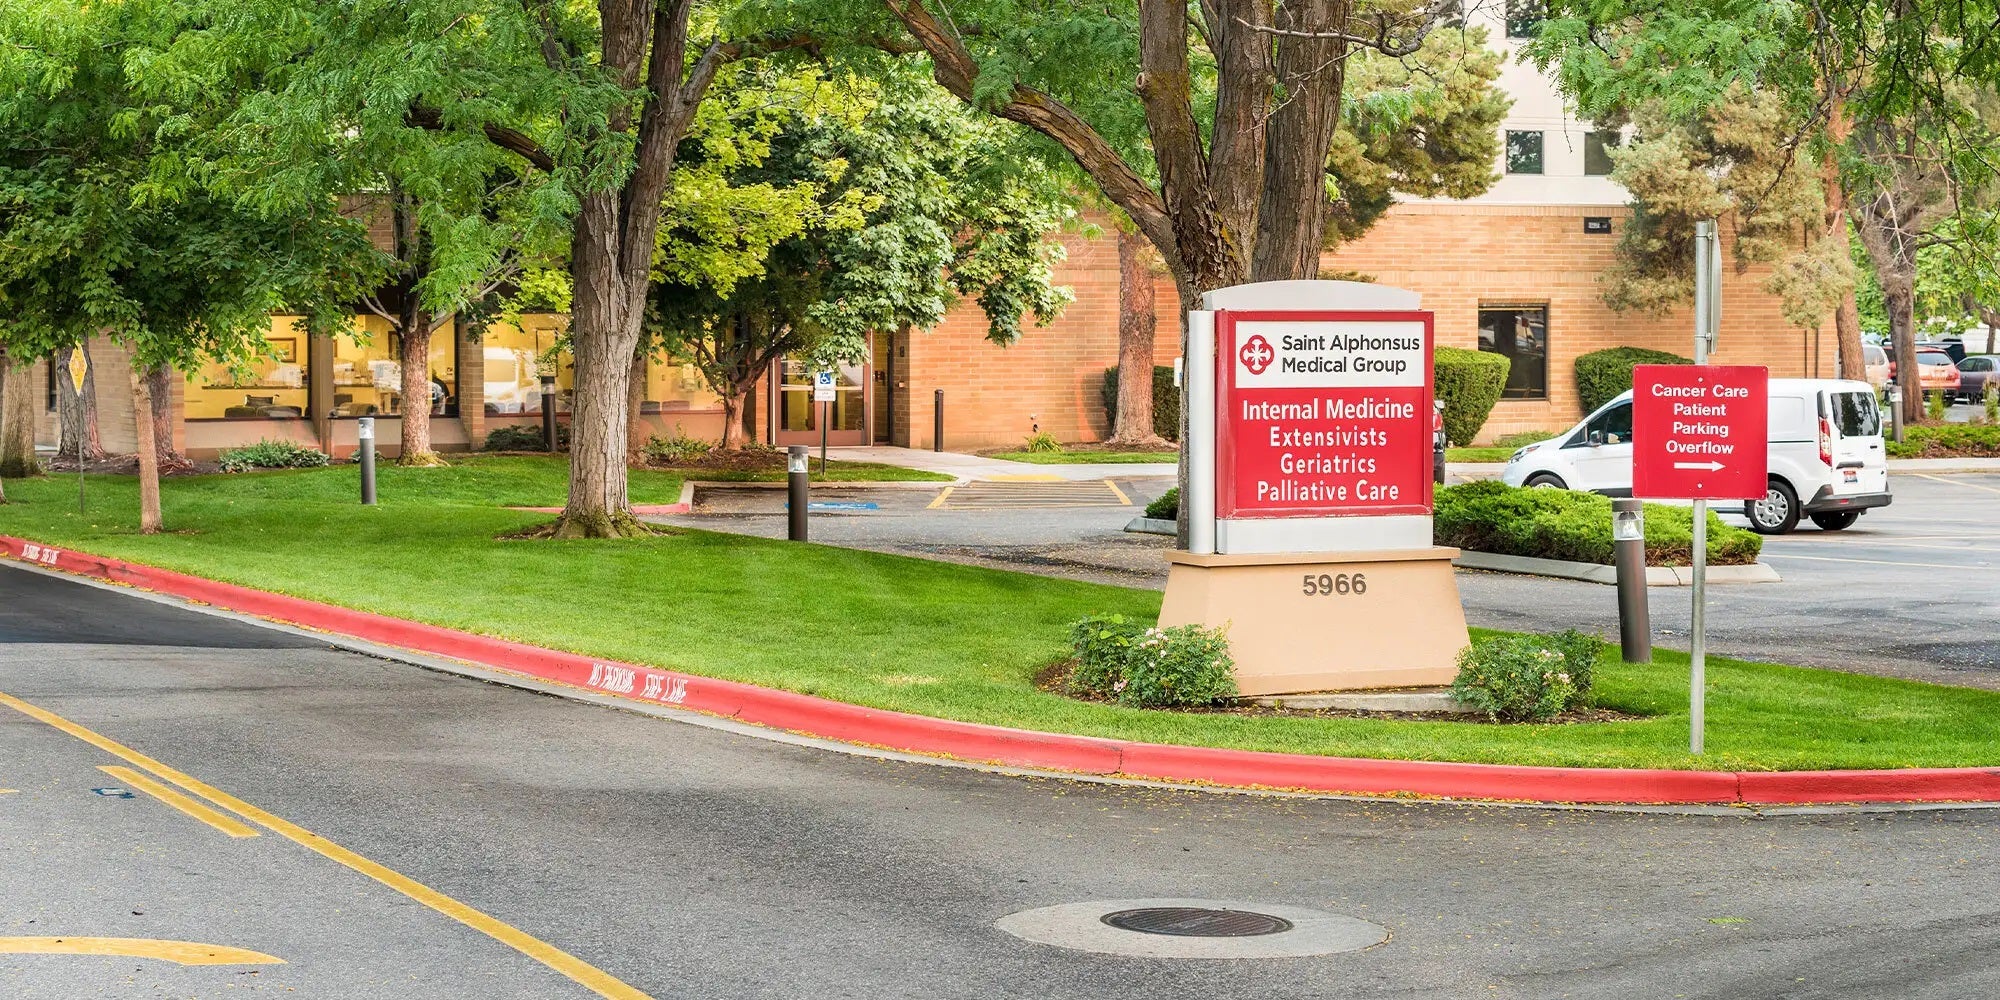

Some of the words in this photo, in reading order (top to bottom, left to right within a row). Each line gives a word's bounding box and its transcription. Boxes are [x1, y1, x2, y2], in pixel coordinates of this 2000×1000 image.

[1281, 334, 1326, 351] Saint
[1329, 334, 1420, 354] Alphonsus
[1282, 356, 1347, 373] Medical
[1353, 356, 1407, 376] Group
[1651, 383, 1707, 398] Cancer
[1712, 384, 1749, 398] Care
[1243, 397, 1319, 421] Internal
[1325, 397, 1414, 420] Medicine
[1673, 402, 1727, 416] Patient
[1270, 426, 1387, 447] Extensivists
[1672, 421, 1729, 439] Parking
[1665, 439, 1735, 455] Overflow
[1280, 453, 1376, 475] Geriatrics
[1257, 479, 1347, 502] Palliative
[1355, 479, 1399, 501] Care
[1302, 573, 1367, 597] 5966
[587, 662, 604, 686] NO
